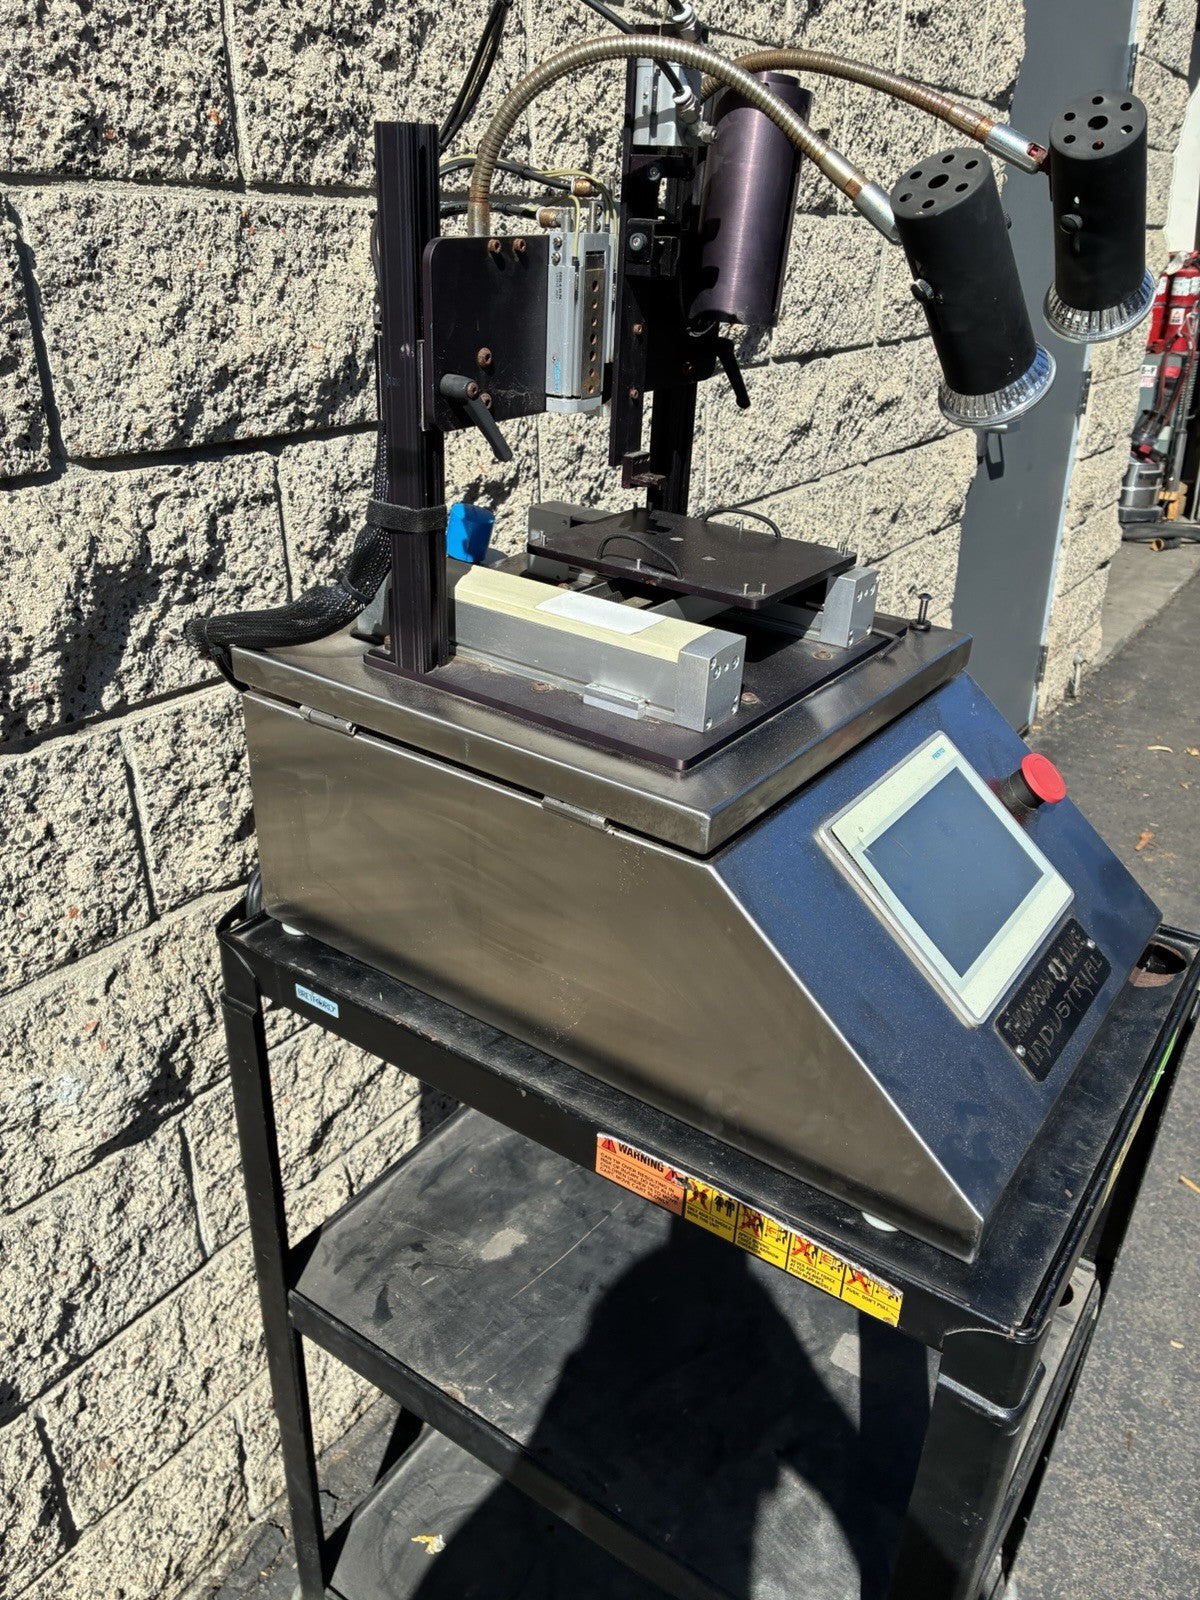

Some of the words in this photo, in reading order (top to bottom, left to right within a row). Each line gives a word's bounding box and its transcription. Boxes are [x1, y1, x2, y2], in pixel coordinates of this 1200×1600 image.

[1027, 954, 1104, 1067] INDUSTRIAL
[618, 1143, 664, 1173] WARNING
[600, 1161, 626, 1179] CHILDREN
[621, 1161, 637, 1173] OVER
[637, 1169, 667, 1190] RESULTING
[631, 1182, 647, 1194] CART
[648, 1180, 660, 1190] NOT
